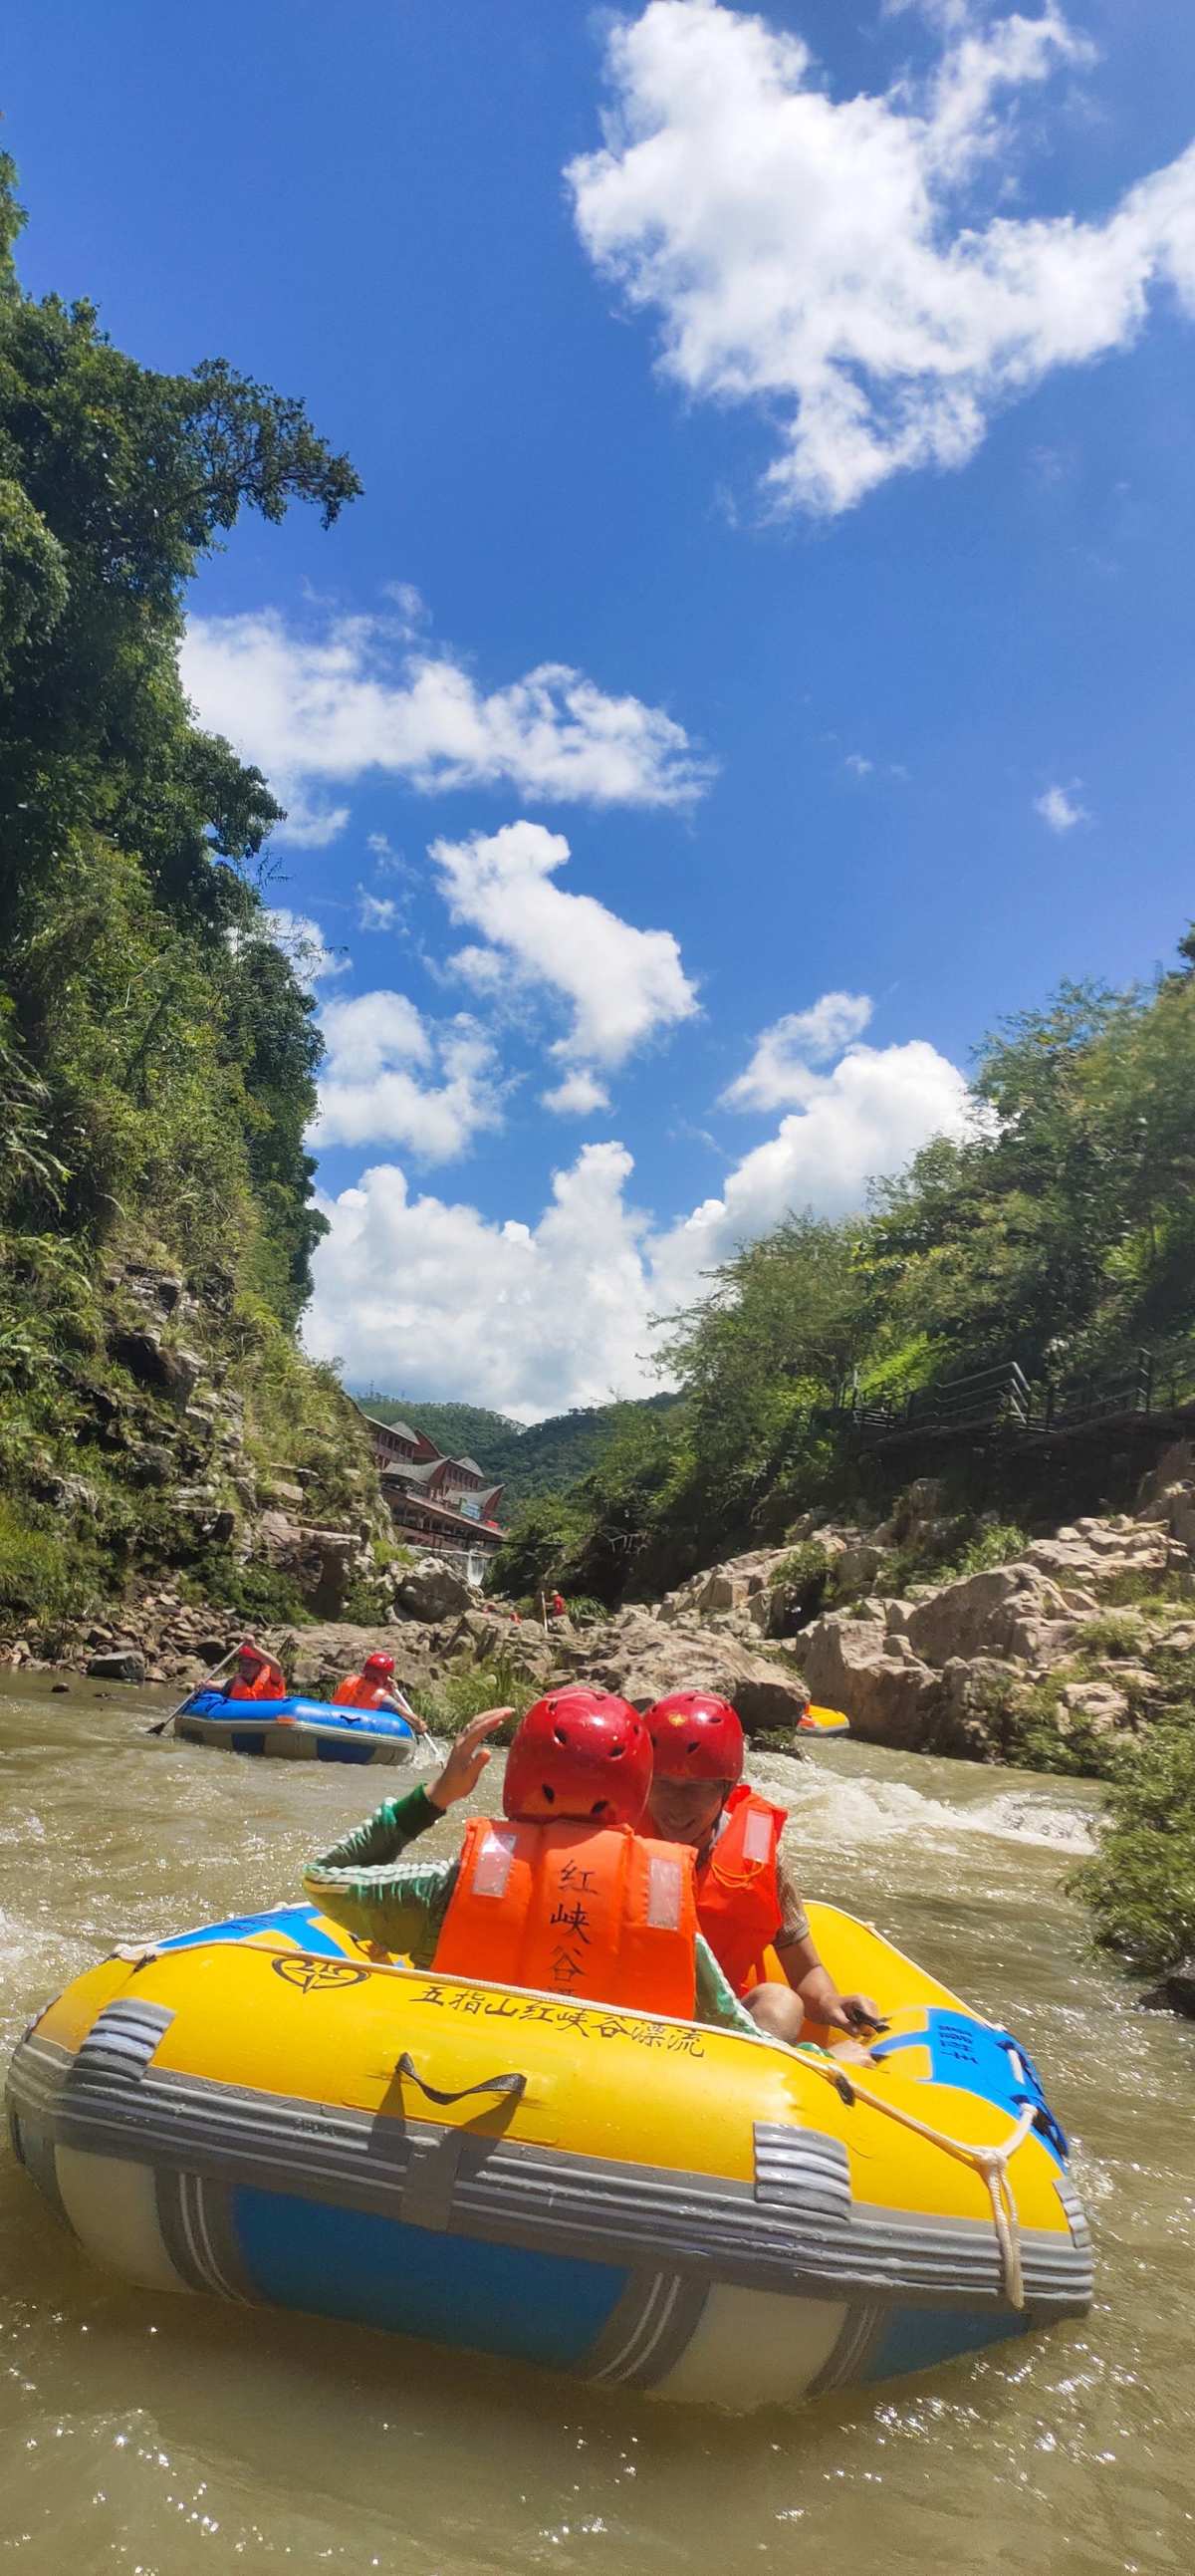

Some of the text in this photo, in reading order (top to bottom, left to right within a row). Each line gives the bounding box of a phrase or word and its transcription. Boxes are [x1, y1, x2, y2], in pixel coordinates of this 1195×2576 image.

[549, 1859, 598, 1995] 红峡谷
[409, 1986, 704, 2058] 五指山红峡谷漂流
